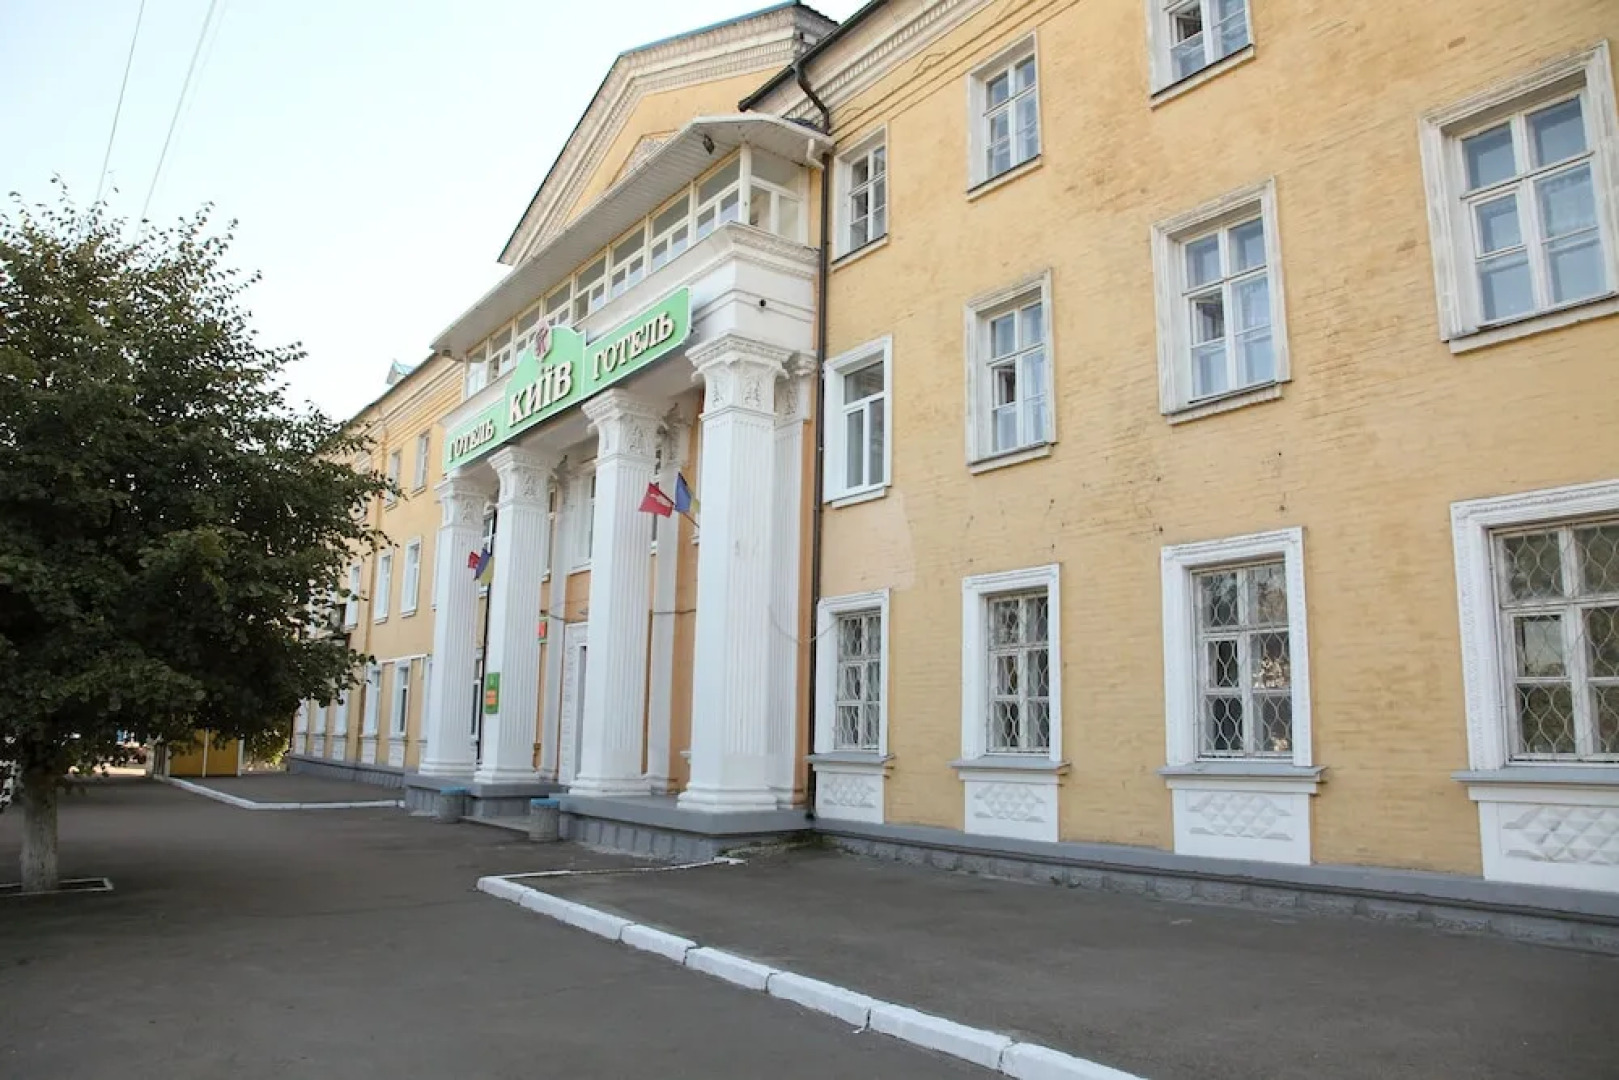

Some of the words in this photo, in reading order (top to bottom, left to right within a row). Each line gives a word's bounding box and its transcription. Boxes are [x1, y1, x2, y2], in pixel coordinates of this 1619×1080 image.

[450, 419, 496, 461] ГОТЕЛЬ
[509, 361, 573, 427] КИЇВ
[593, 313, 674, 380] ГОТЕЛЬ
